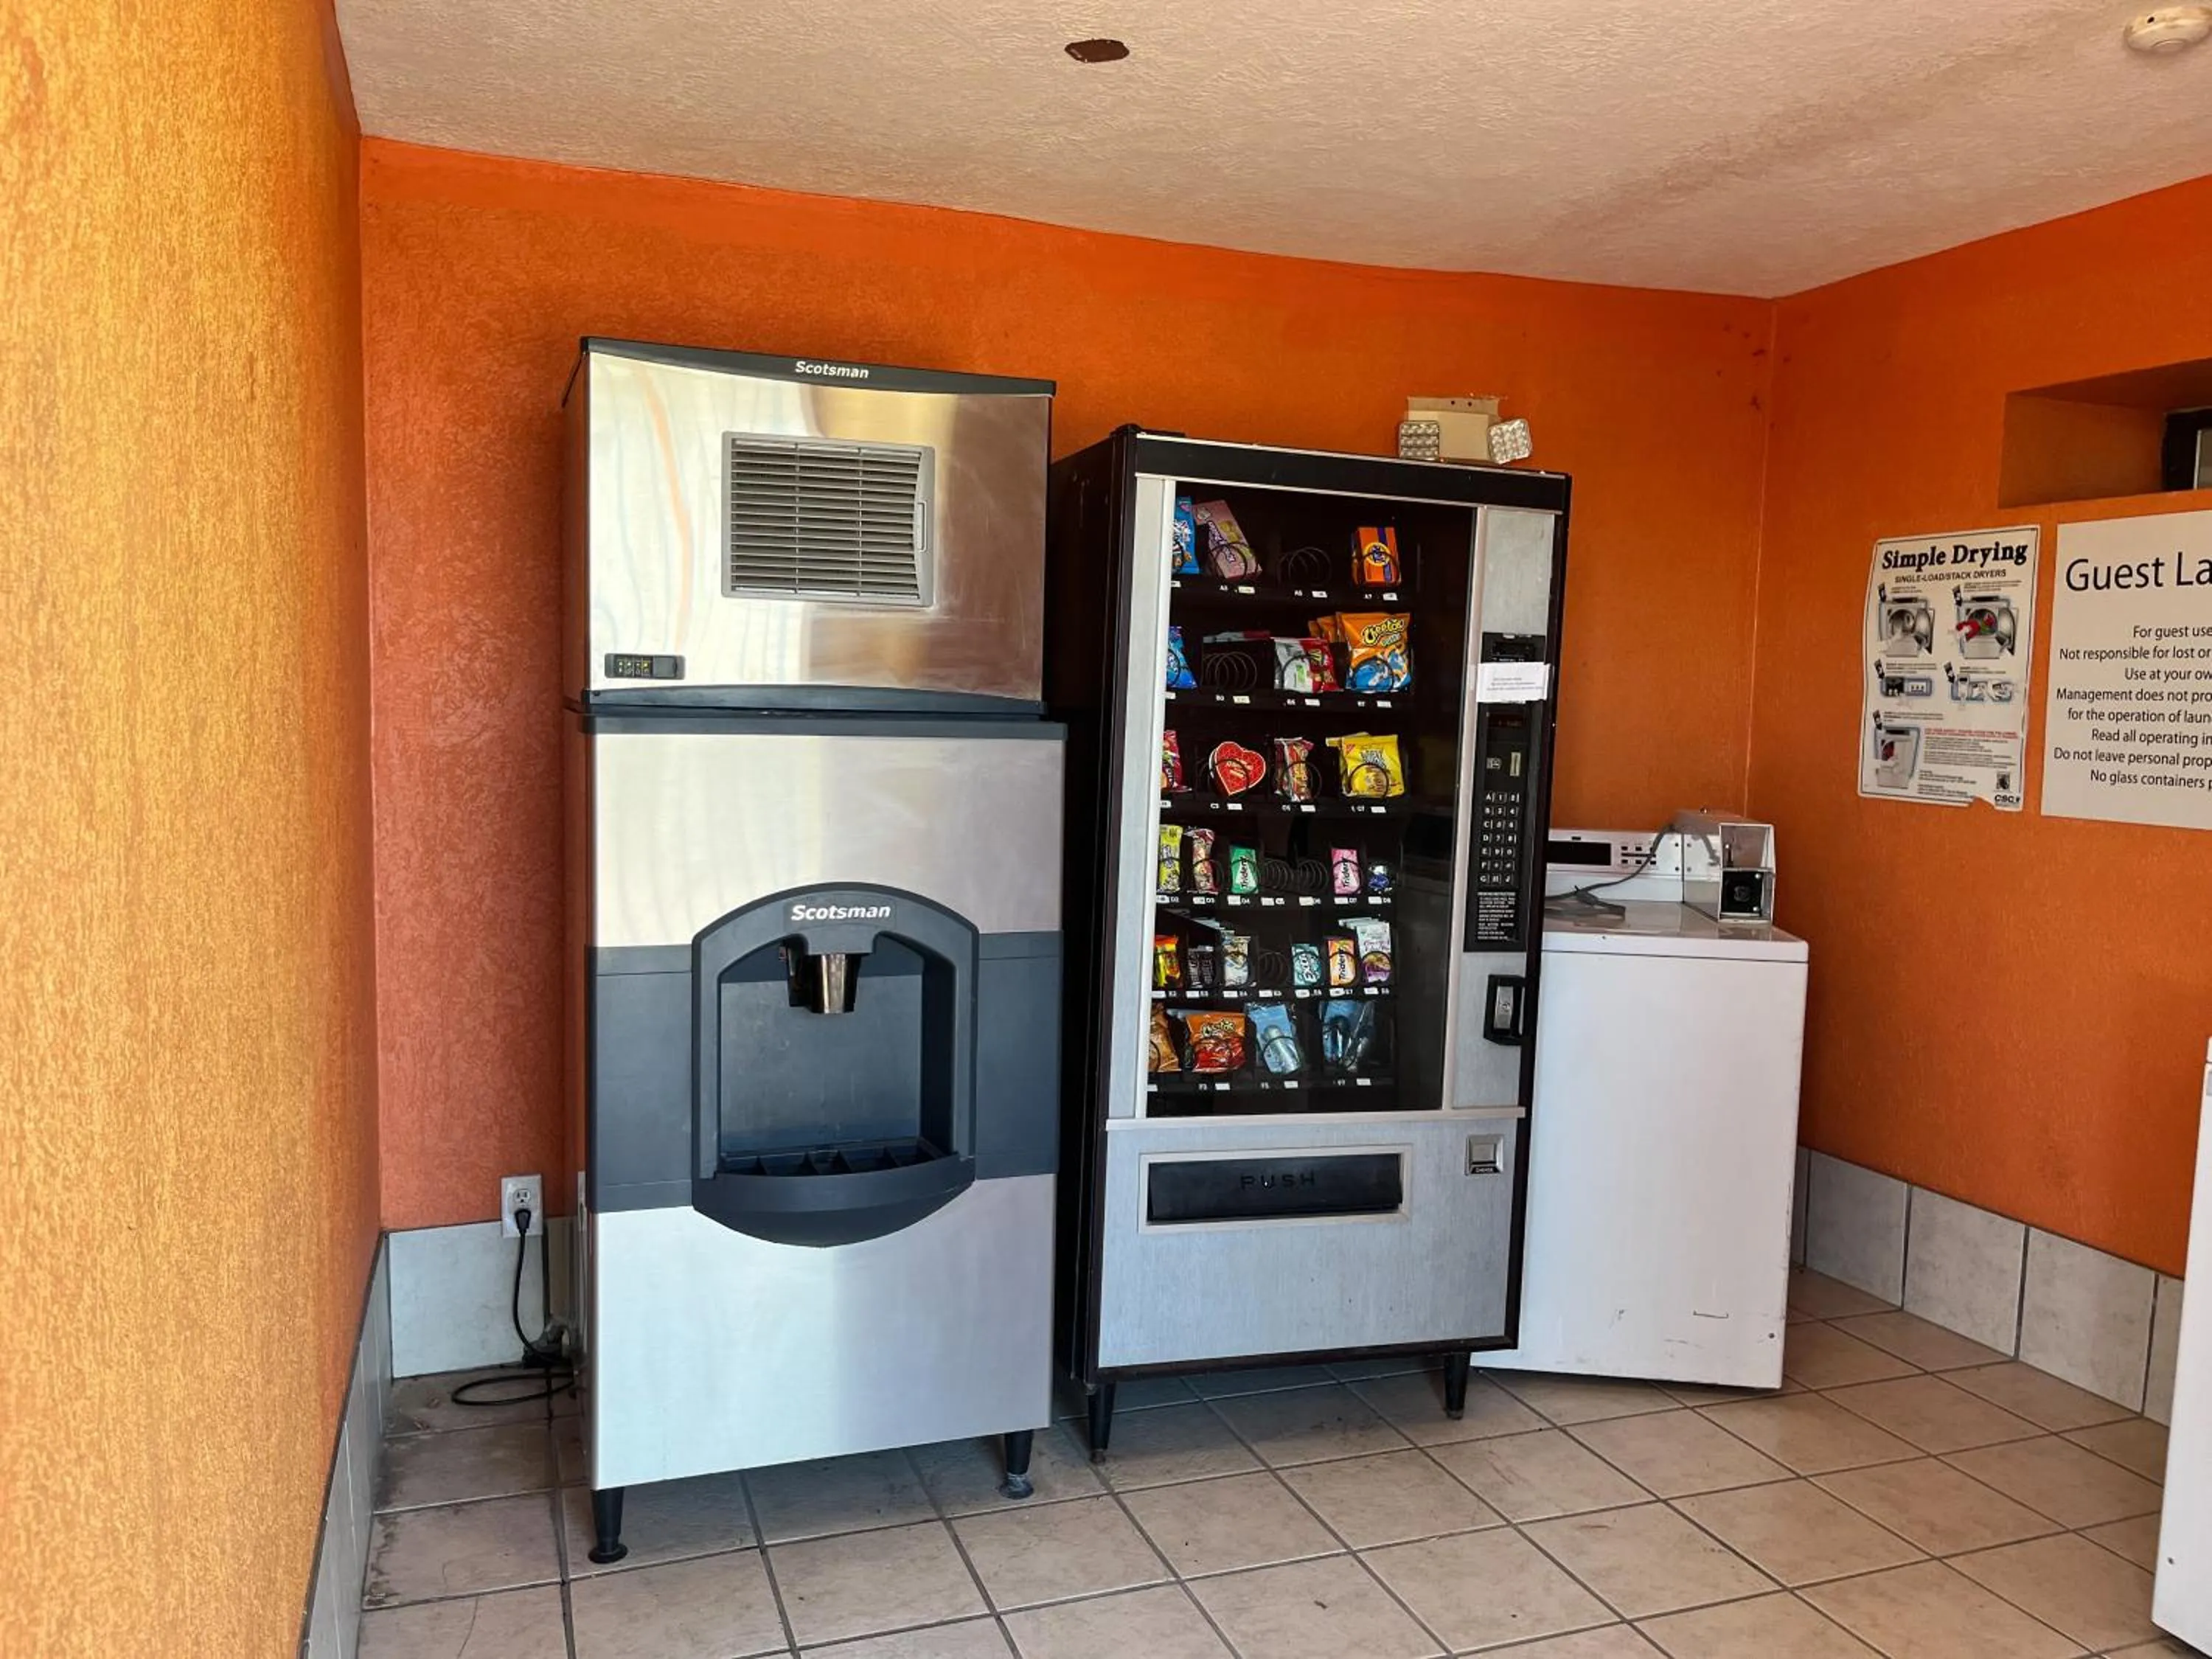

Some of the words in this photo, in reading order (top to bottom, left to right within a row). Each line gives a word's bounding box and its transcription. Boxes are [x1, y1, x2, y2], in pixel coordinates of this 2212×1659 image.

[795, 361, 869, 378] Scotsman
[1882, 546, 1946, 572] Simple
[1951, 541, 2028, 566] Drying
[1973, 569, 2006, 579] DRYERS
[2066, 557, 2165, 591] Guest
[2177, 552, 2212, 586] La
[2133, 625, 2152, 638] For
[2155, 626, 2189, 641] guest
[2192, 627, 2212, 637] use
[2059, 648, 2080, 660] Not
[2083, 646, 2150, 661] responsible
[2153, 645, 2170, 658] for
[2173, 646, 2194, 658] lost
[2198, 649, 2211, 658] or
[2125, 667, 2146, 681] Use
[2149, 669, 2161, 681] at
[2164, 669, 2191, 684] your
[2194, 669, 2212, 681] ow
[2056, 688, 2133, 703] Management
[2135, 689, 2164, 701] does
[2167, 690, 2188, 701] not
[2191, 692, 2212, 705] pro
[2067, 707, 2084, 720] for
[2086, 708, 2105, 720] the
[2108, 709, 2166, 723] operation
[2168, 710, 2182, 723] of
[2184, 710, 2211, 723] laun
[2092, 728, 2120, 741] Read
[2123, 729, 2136, 742] all
[2139, 731, 2198, 748] operating
[2202, 731, 2212, 745] in
[2053, 747, 2070, 759] Do
[2073, 749, 2092, 761] not
[2096, 749, 2126, 762] leave
[2127, 753, 2180, 766] personal
[2183, 756, 2212, 770] prop
[2090, 769, 2107, 782] No
[2110, 771, 2138, 785] glass
[2140, 773, 2205, 788] containers
[791, 905, 891, 921] Scotsman
[1241, 1170, 1315, 1191] PUSH
